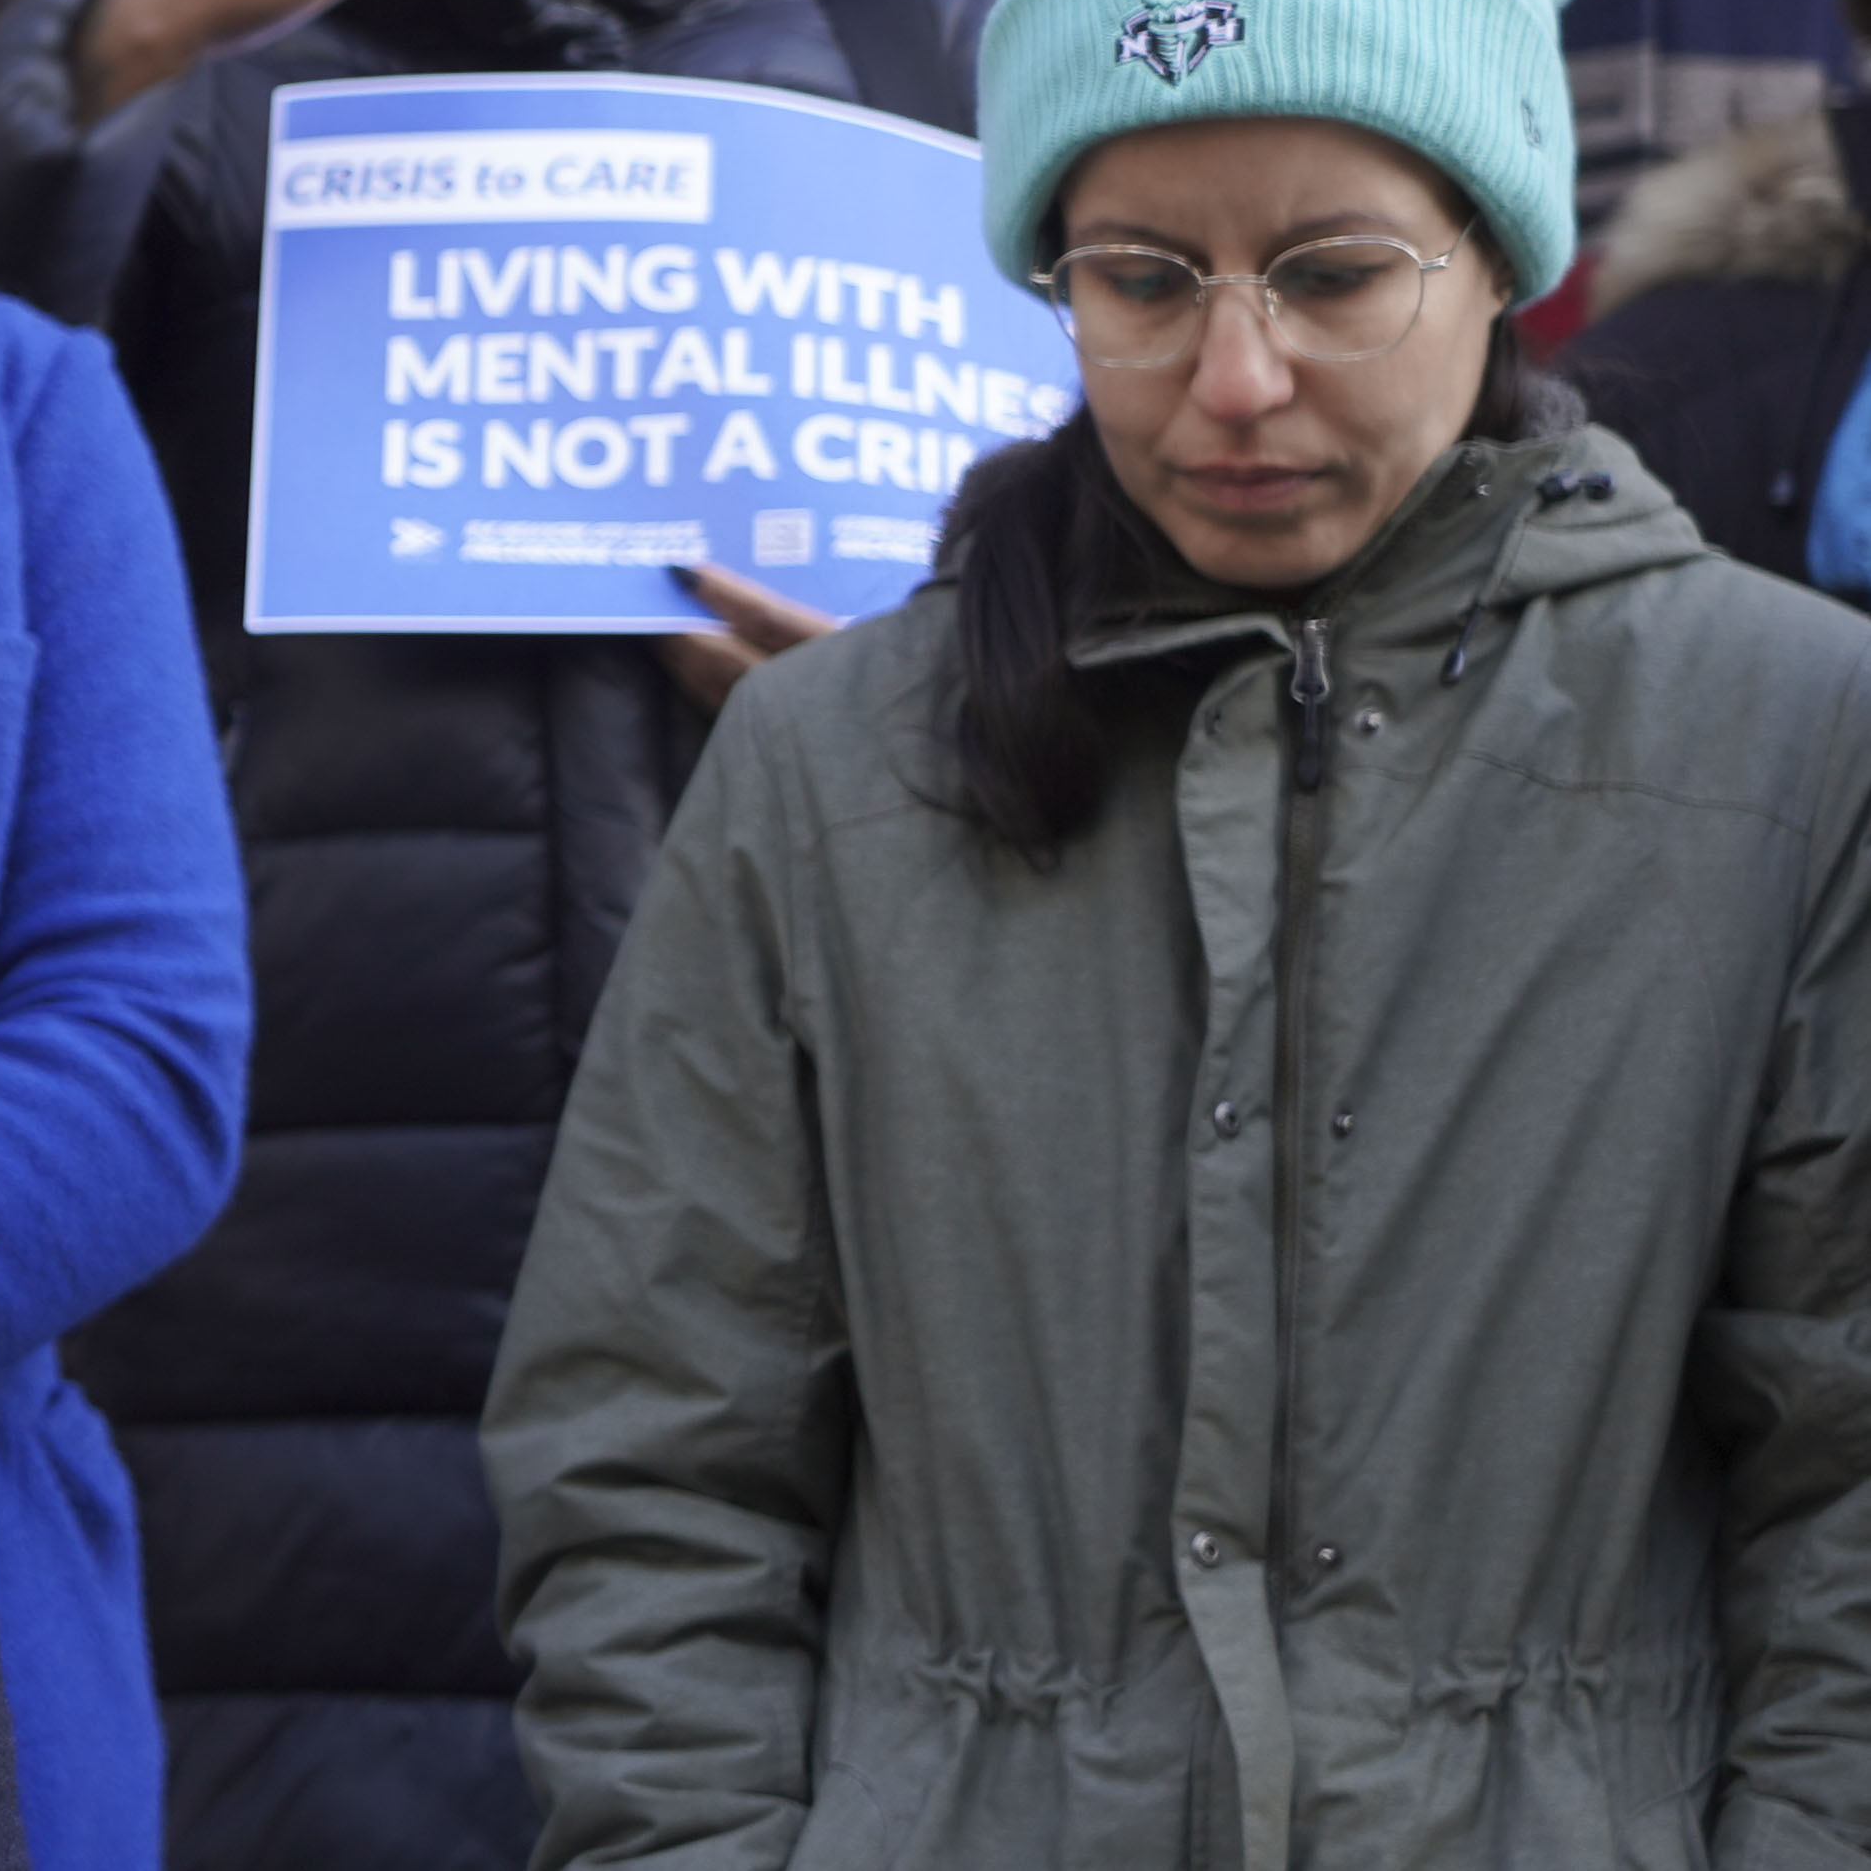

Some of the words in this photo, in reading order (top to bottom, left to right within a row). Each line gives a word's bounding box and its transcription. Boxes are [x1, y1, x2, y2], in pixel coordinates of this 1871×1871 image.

[283, 156, 456, 207] CRISIS
[474, 158, 526, 197] to
[543, 154, 695, 201] CARE
[388, 245, 698, 320] LIVING
[715, 247, 966, 347] WITH
[385, 327, 771, 406] MENTAL
[381, 419, 465, 489] IS
[482, 413, 689, 490] NOT
[705, 413, 777, 483] A
